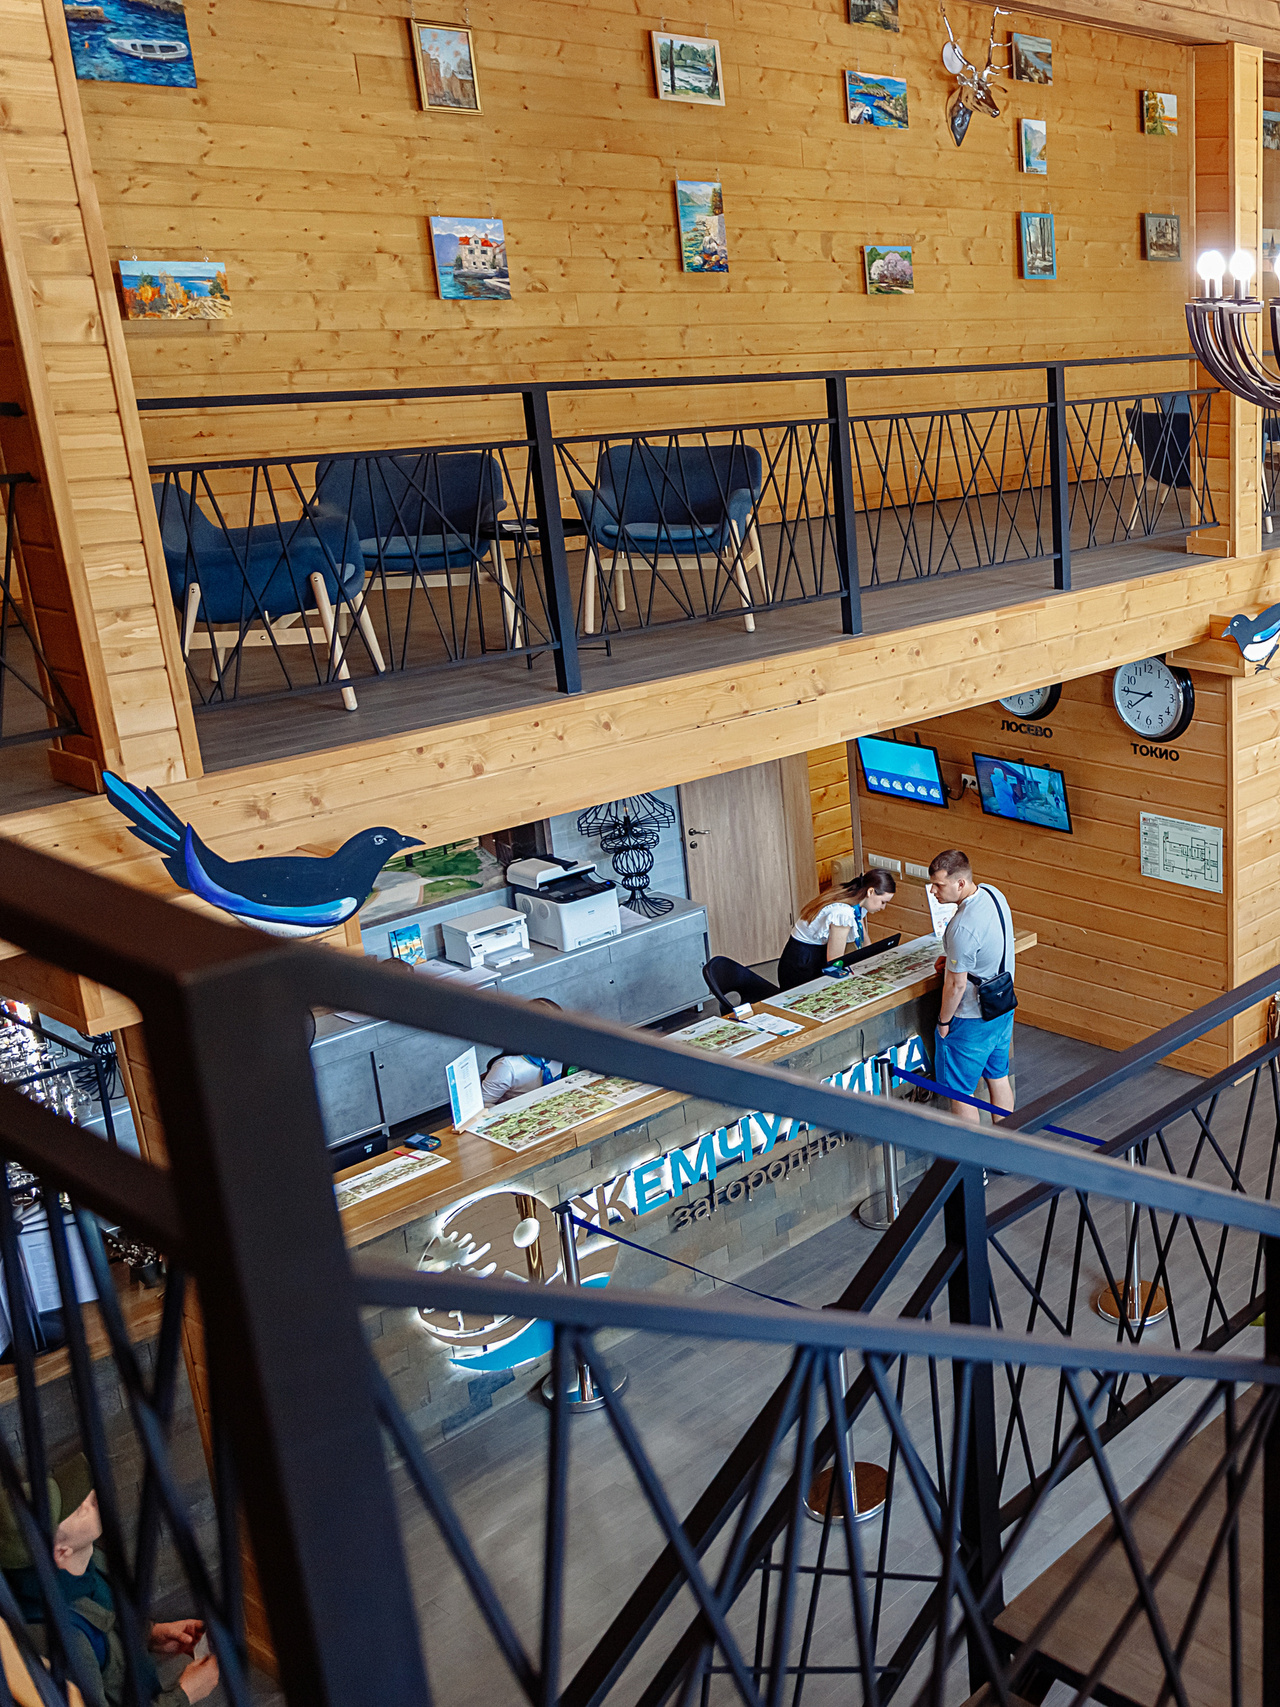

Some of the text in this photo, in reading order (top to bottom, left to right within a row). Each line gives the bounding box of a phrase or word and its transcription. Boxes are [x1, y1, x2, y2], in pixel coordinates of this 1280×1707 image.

[1134, 667, 1142, 676] 11
[1143, 664, 1153, 674] 12
[1157, 669, 1161, 679] 1
[1127, 675, 1136, 685] 10
[1164, 679, 1170, 688] 2
[1018, 696, 1024, 706] 6
[1169, 694, 1175, 703] 3
[1127, 700, 1133, 709] 8
[1136, 711, 1142, 720] 7
[1165, 707, 1171, 715] 4
[1146, 715, 1152, 726] 6
[1158, 715, 1164, 724] 5
[1000, 719, 1053, 739] ЛОСЕВО
[1130, 742, 1180, 762] ТОКИО
[567, 1033, 932, 1246] ЖЕМЧУИНА
[674, 1130, 848, 1231] загородны
